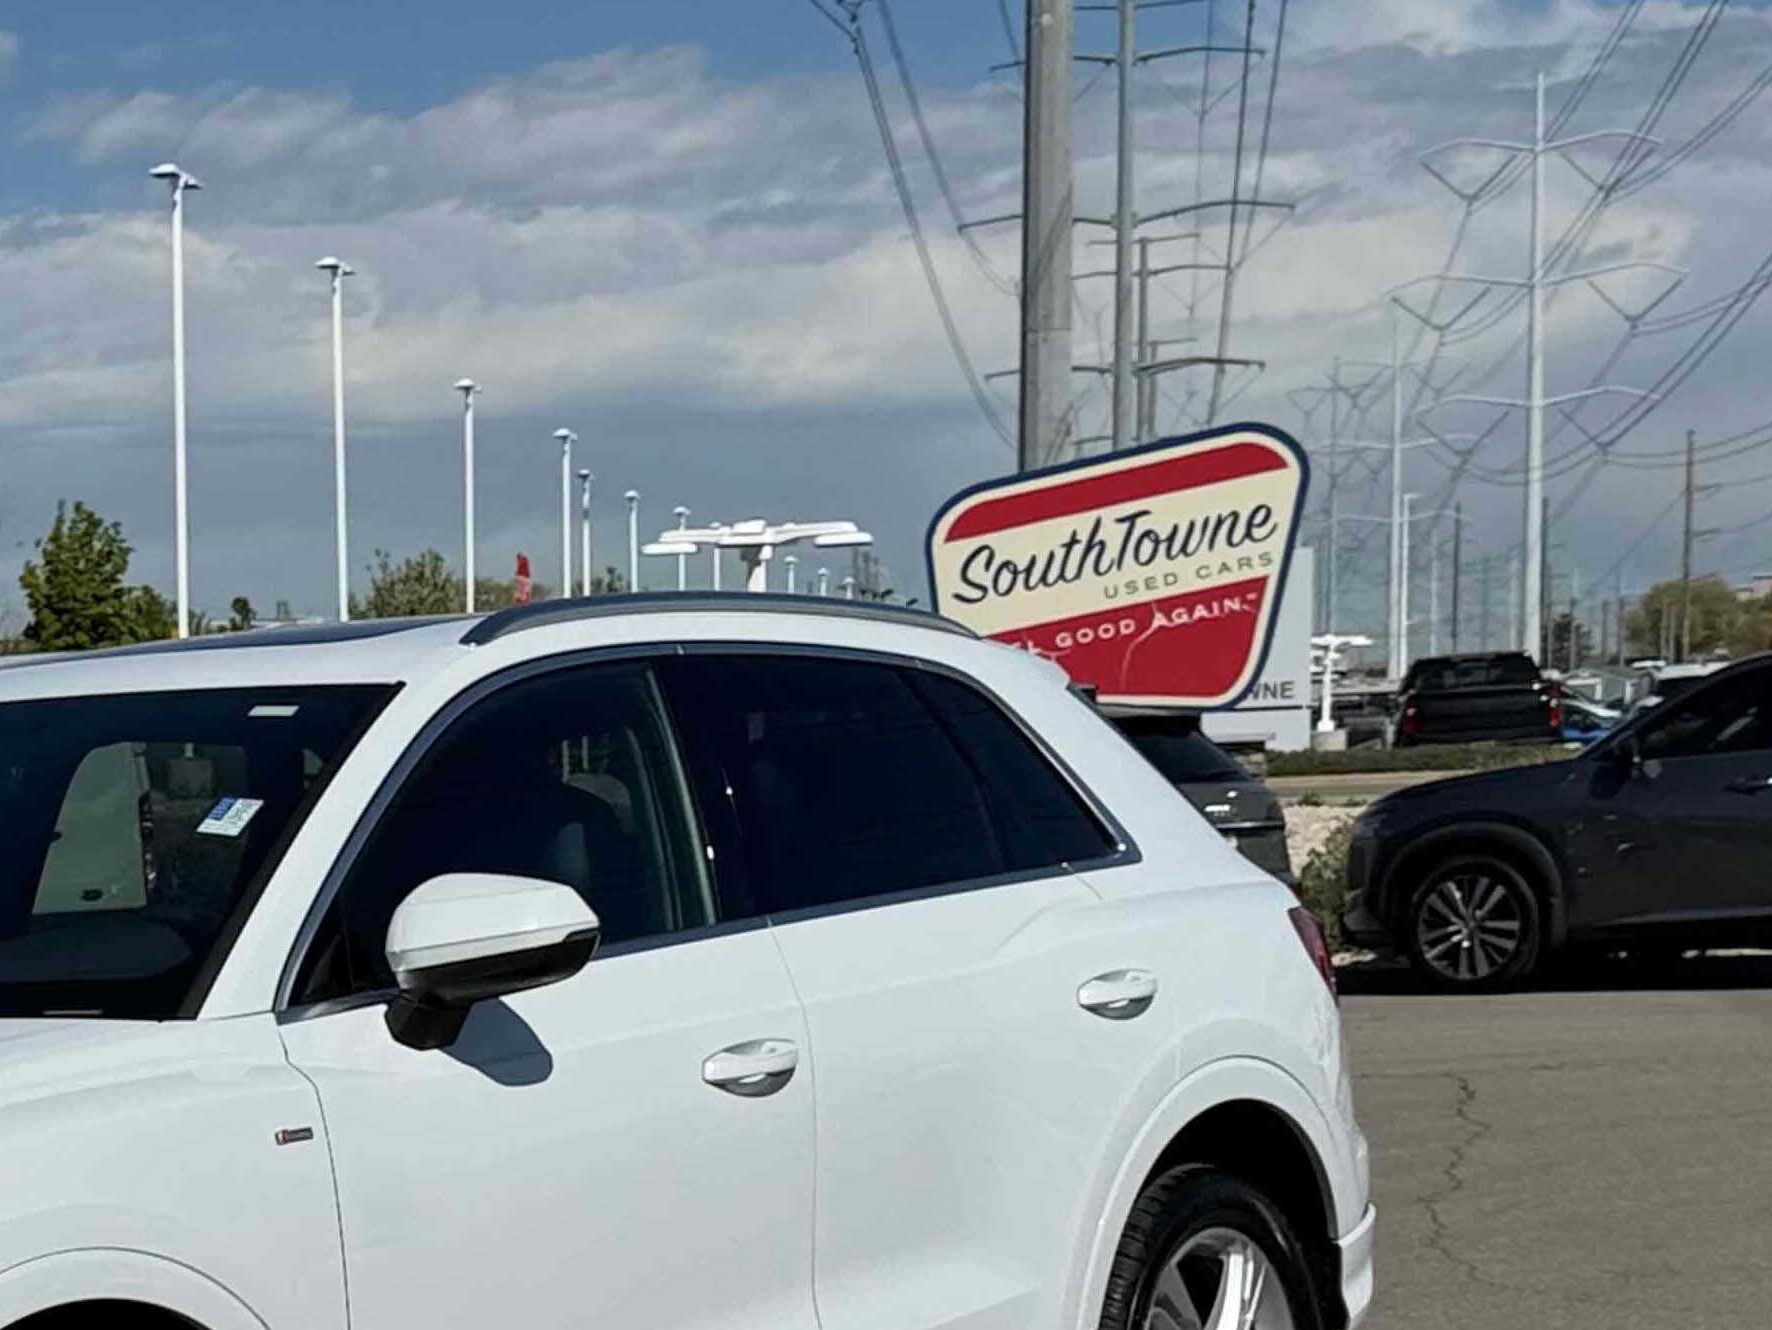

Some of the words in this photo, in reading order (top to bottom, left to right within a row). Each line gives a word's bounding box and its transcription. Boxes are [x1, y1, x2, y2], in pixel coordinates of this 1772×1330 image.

[952, 504, 1278, 604] SouthTowne
[1104, 572, 1178, 599] USED
[1195, 552, 1274, 580] CARS
[1055, 618, 1136, 648] GOOD
